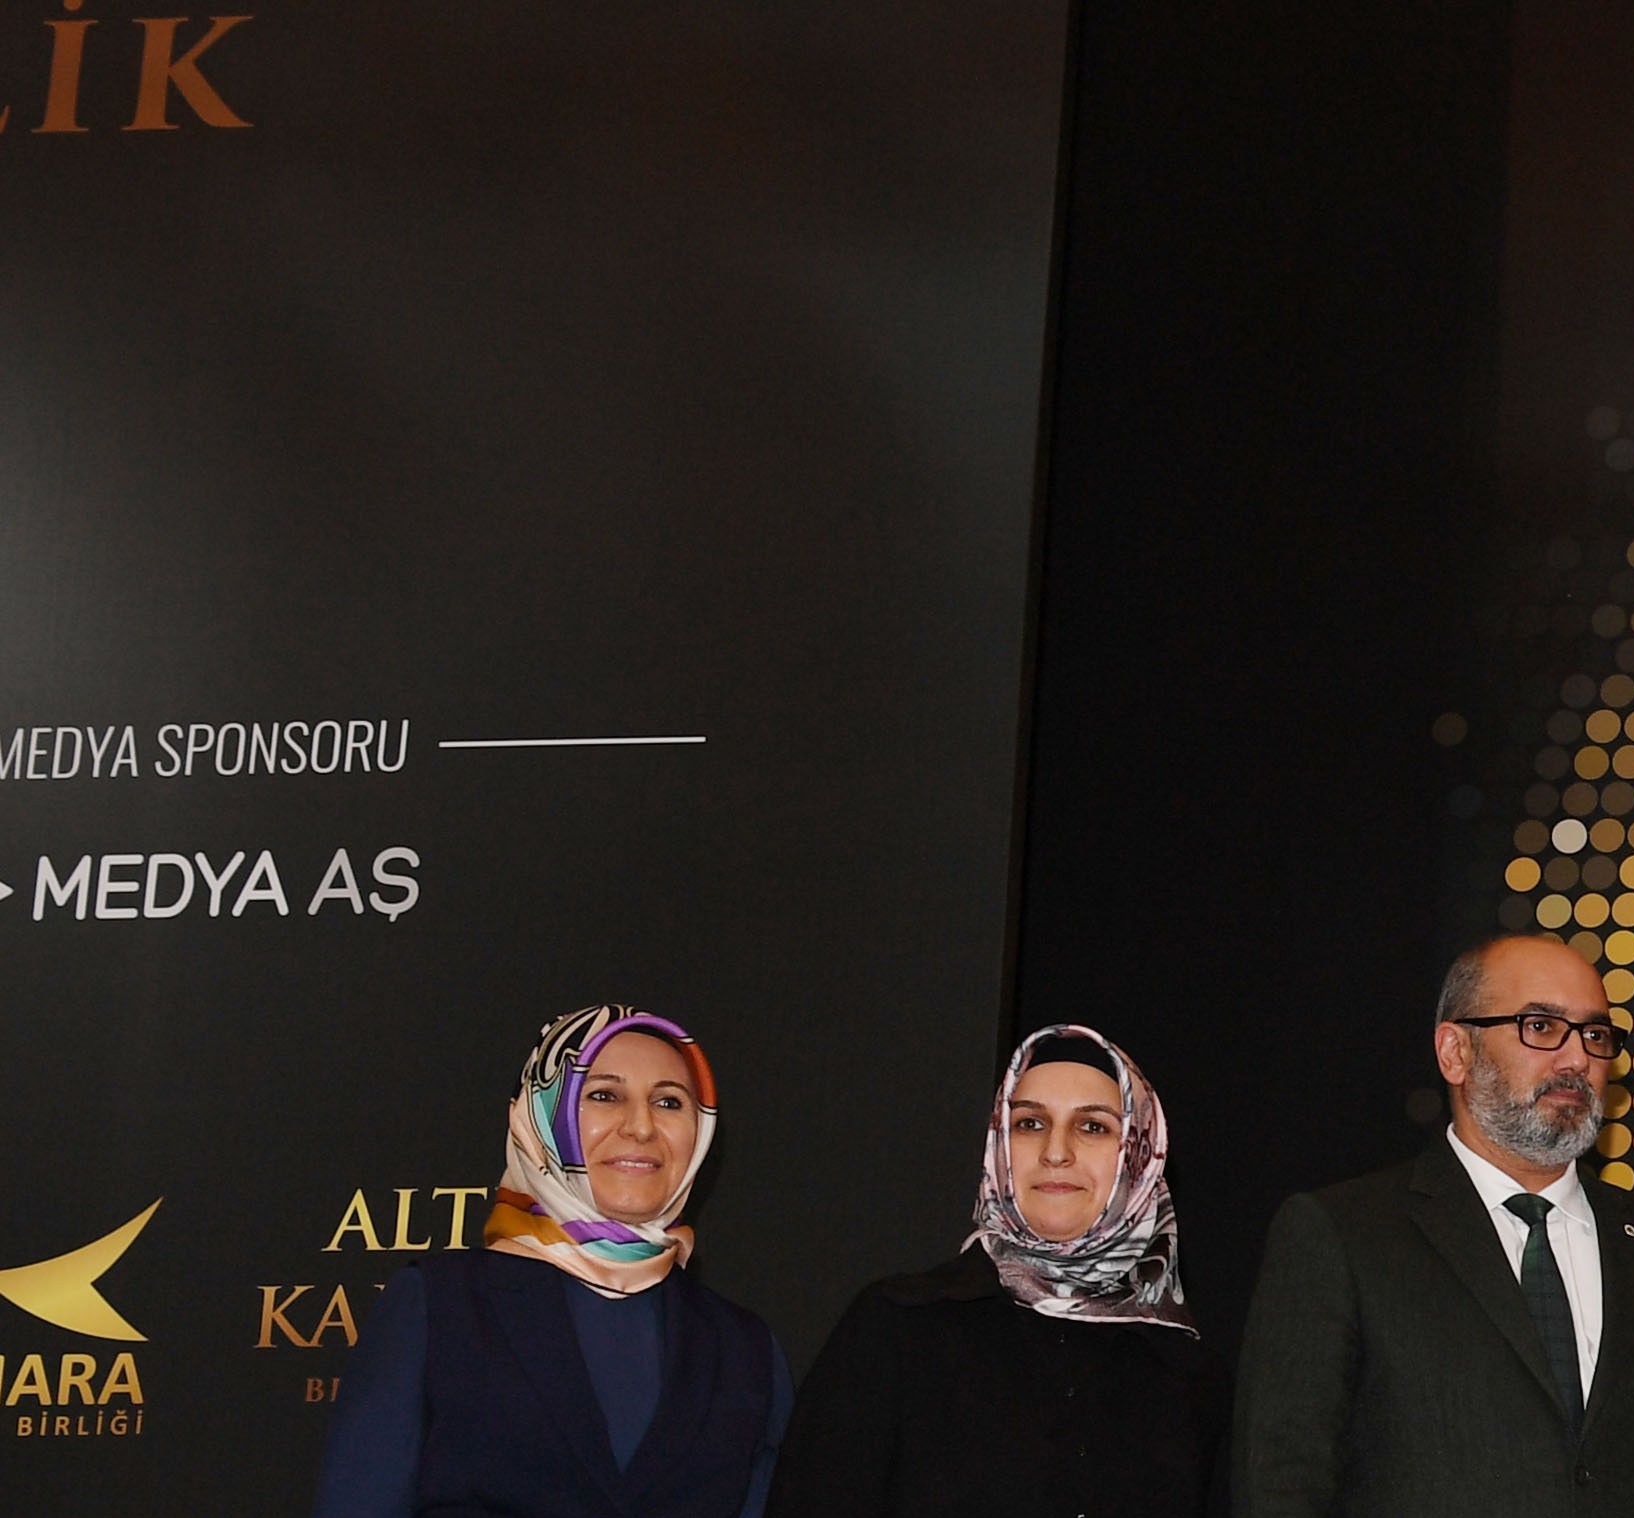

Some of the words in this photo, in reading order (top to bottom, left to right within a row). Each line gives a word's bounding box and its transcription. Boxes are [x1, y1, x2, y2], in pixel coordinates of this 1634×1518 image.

[0, 0, 254, 133] İK
[155, 719, 409, 777] SPONSORU
[33, 850, 289, 921] MEDYA
[307, 846, 420, 922] AŞ
[321, 1186, 488, 1252] ALT
[0, 1353, 144, 1406] ARA
[17, 1410, 143, 1437] BİRLİĞİ
